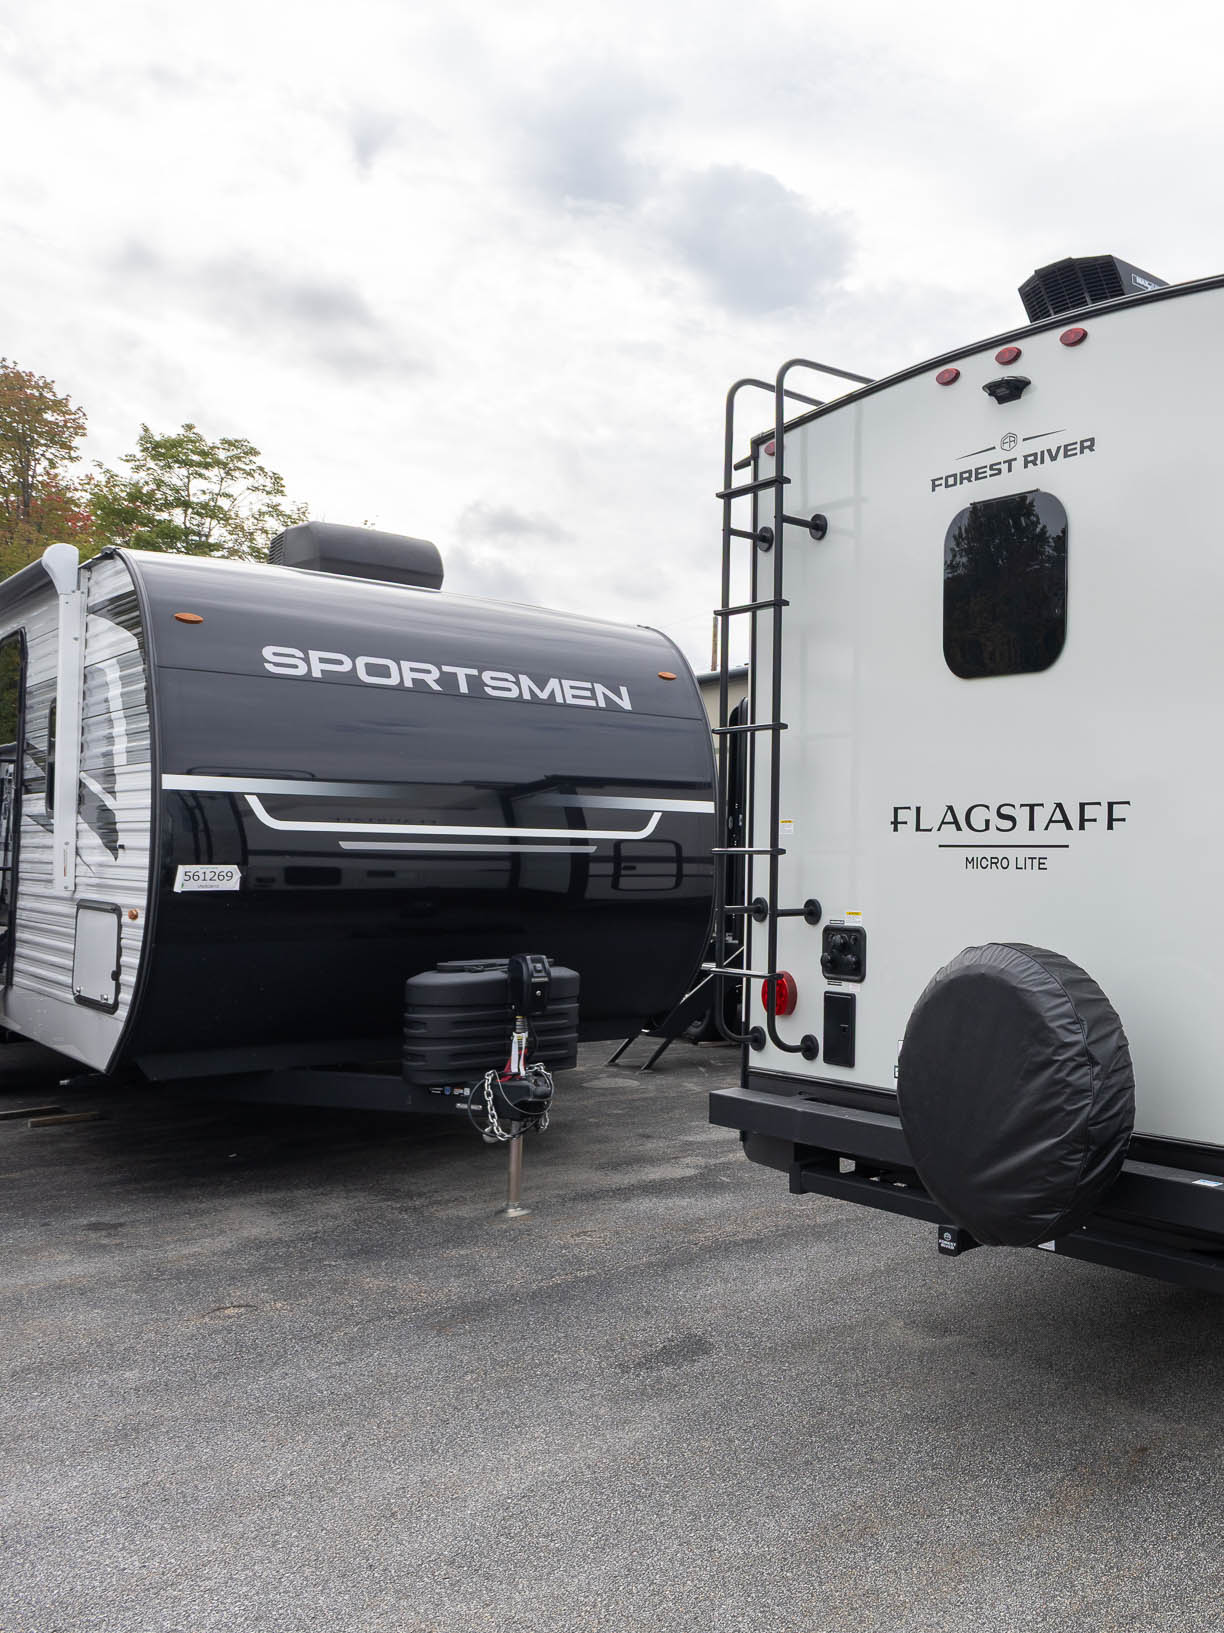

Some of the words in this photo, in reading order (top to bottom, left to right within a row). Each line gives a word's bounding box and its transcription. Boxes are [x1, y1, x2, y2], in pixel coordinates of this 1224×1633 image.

[930, 457, 1018, 493] FOREST
[1023, 437, 1096, 469] RIVER
[261, 645, 633, 711] SPORTSMEN
[890, 800, 1131, 833] FLAGSTAFF
[183, 870, 234, 882] 561269
[965, 856, 1010, 870] MICRO
[1015, 857, 1048, 870] LITE
